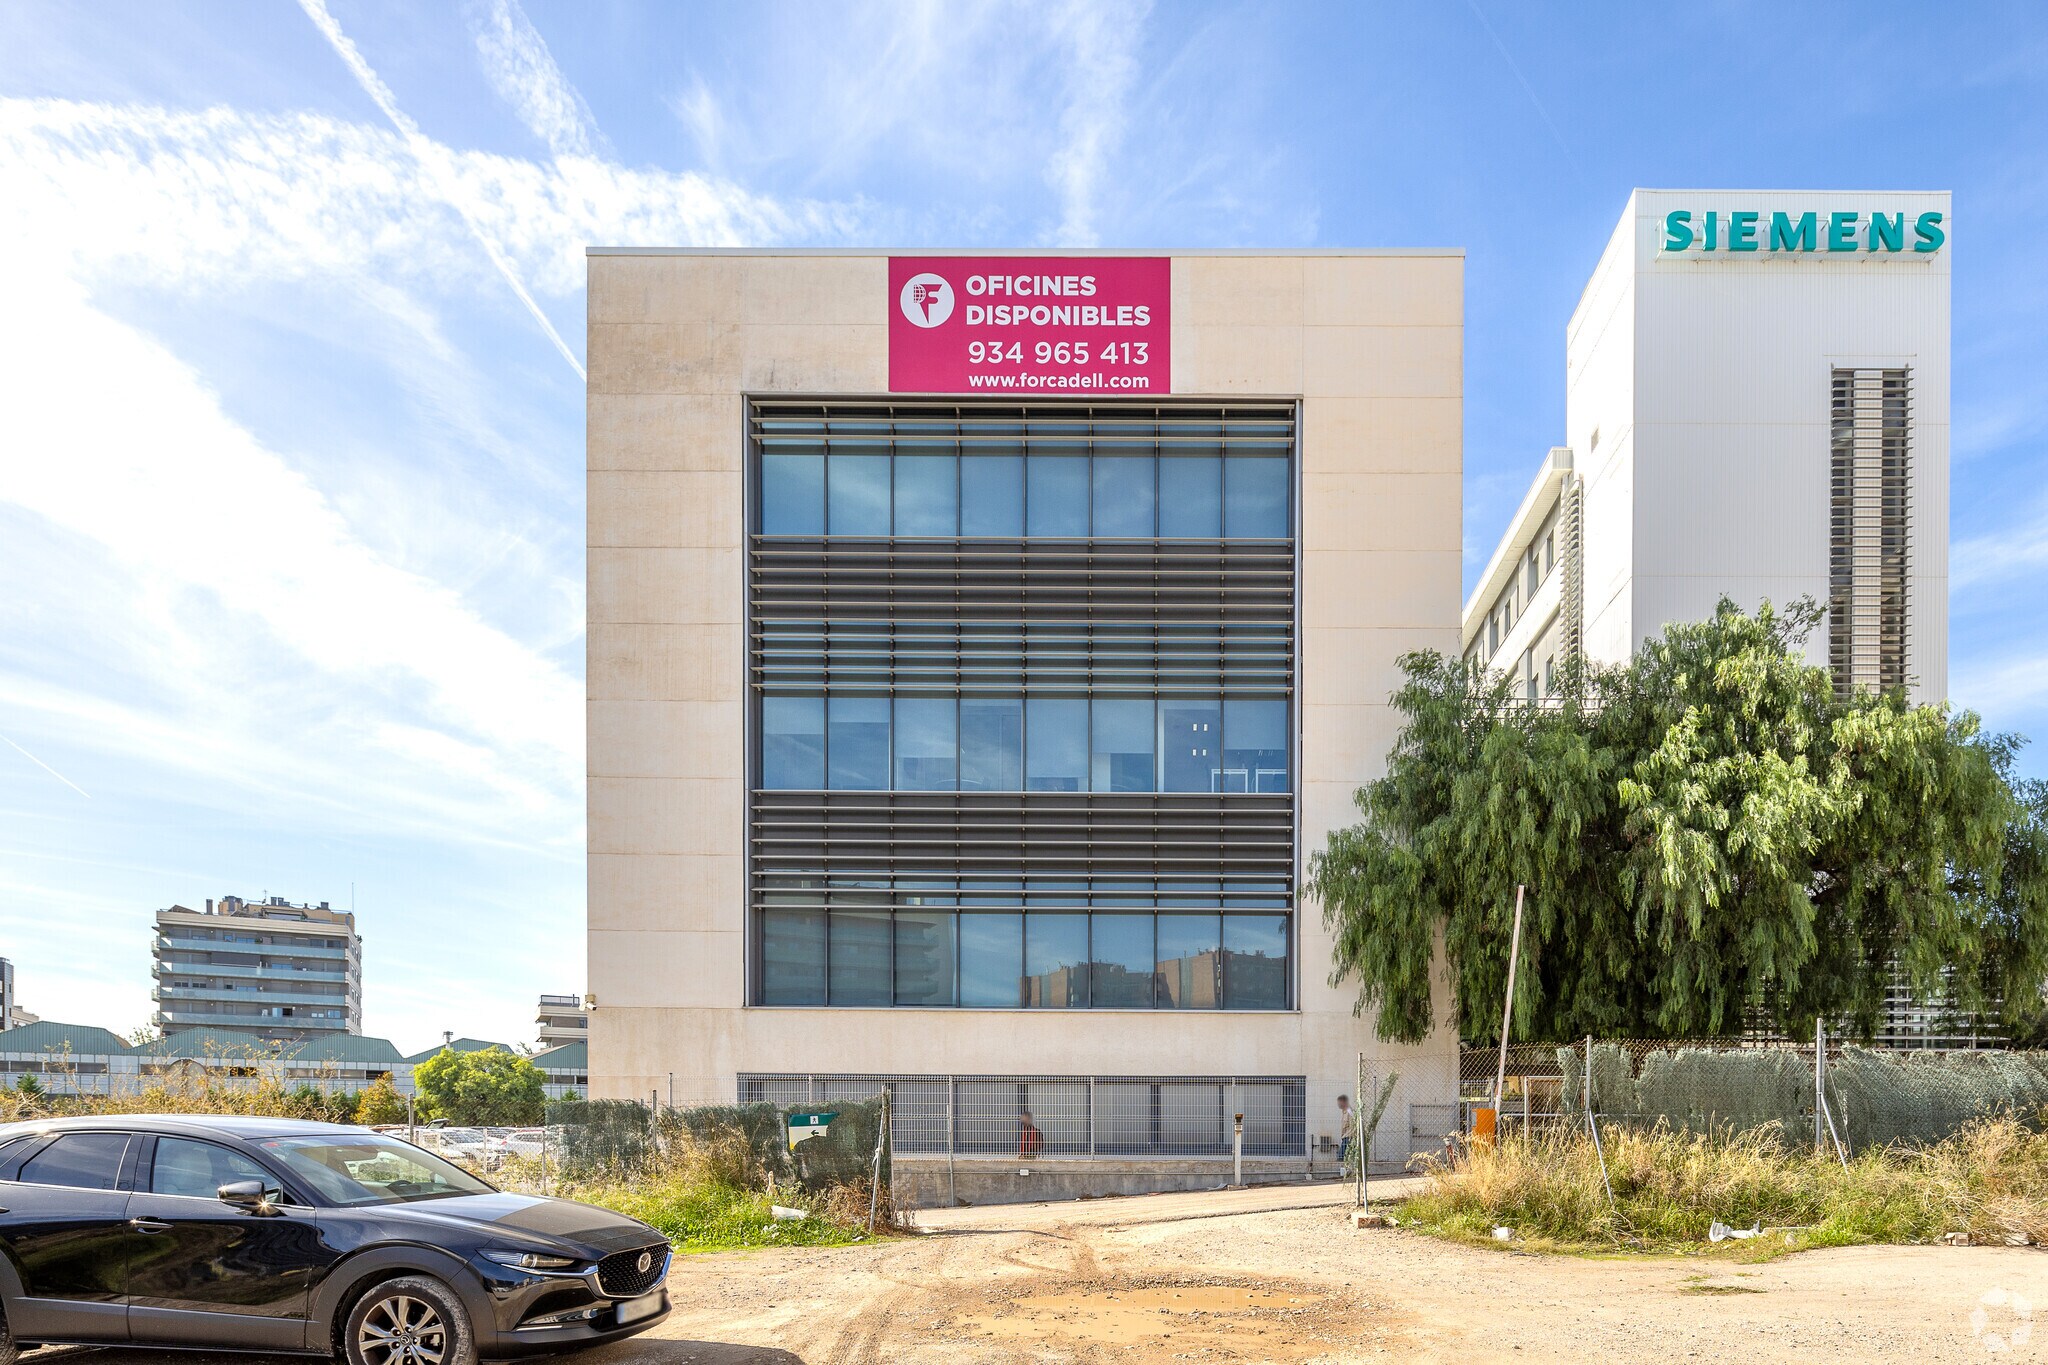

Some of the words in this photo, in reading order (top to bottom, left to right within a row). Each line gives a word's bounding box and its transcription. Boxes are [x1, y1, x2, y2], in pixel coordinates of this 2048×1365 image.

[1663, 210, 1945, 253] SIEMENS
[965, 275, 1097, 296] OFICINES
[966, 305, 1151, 326] DISPONIBLES
[968, 341, 1024, 364] 934
[1035, 341, 1090, 364] 965
[1100, 341, 1149, 364] 413
[968, 373, 1149, 388] www.forcadell.com
